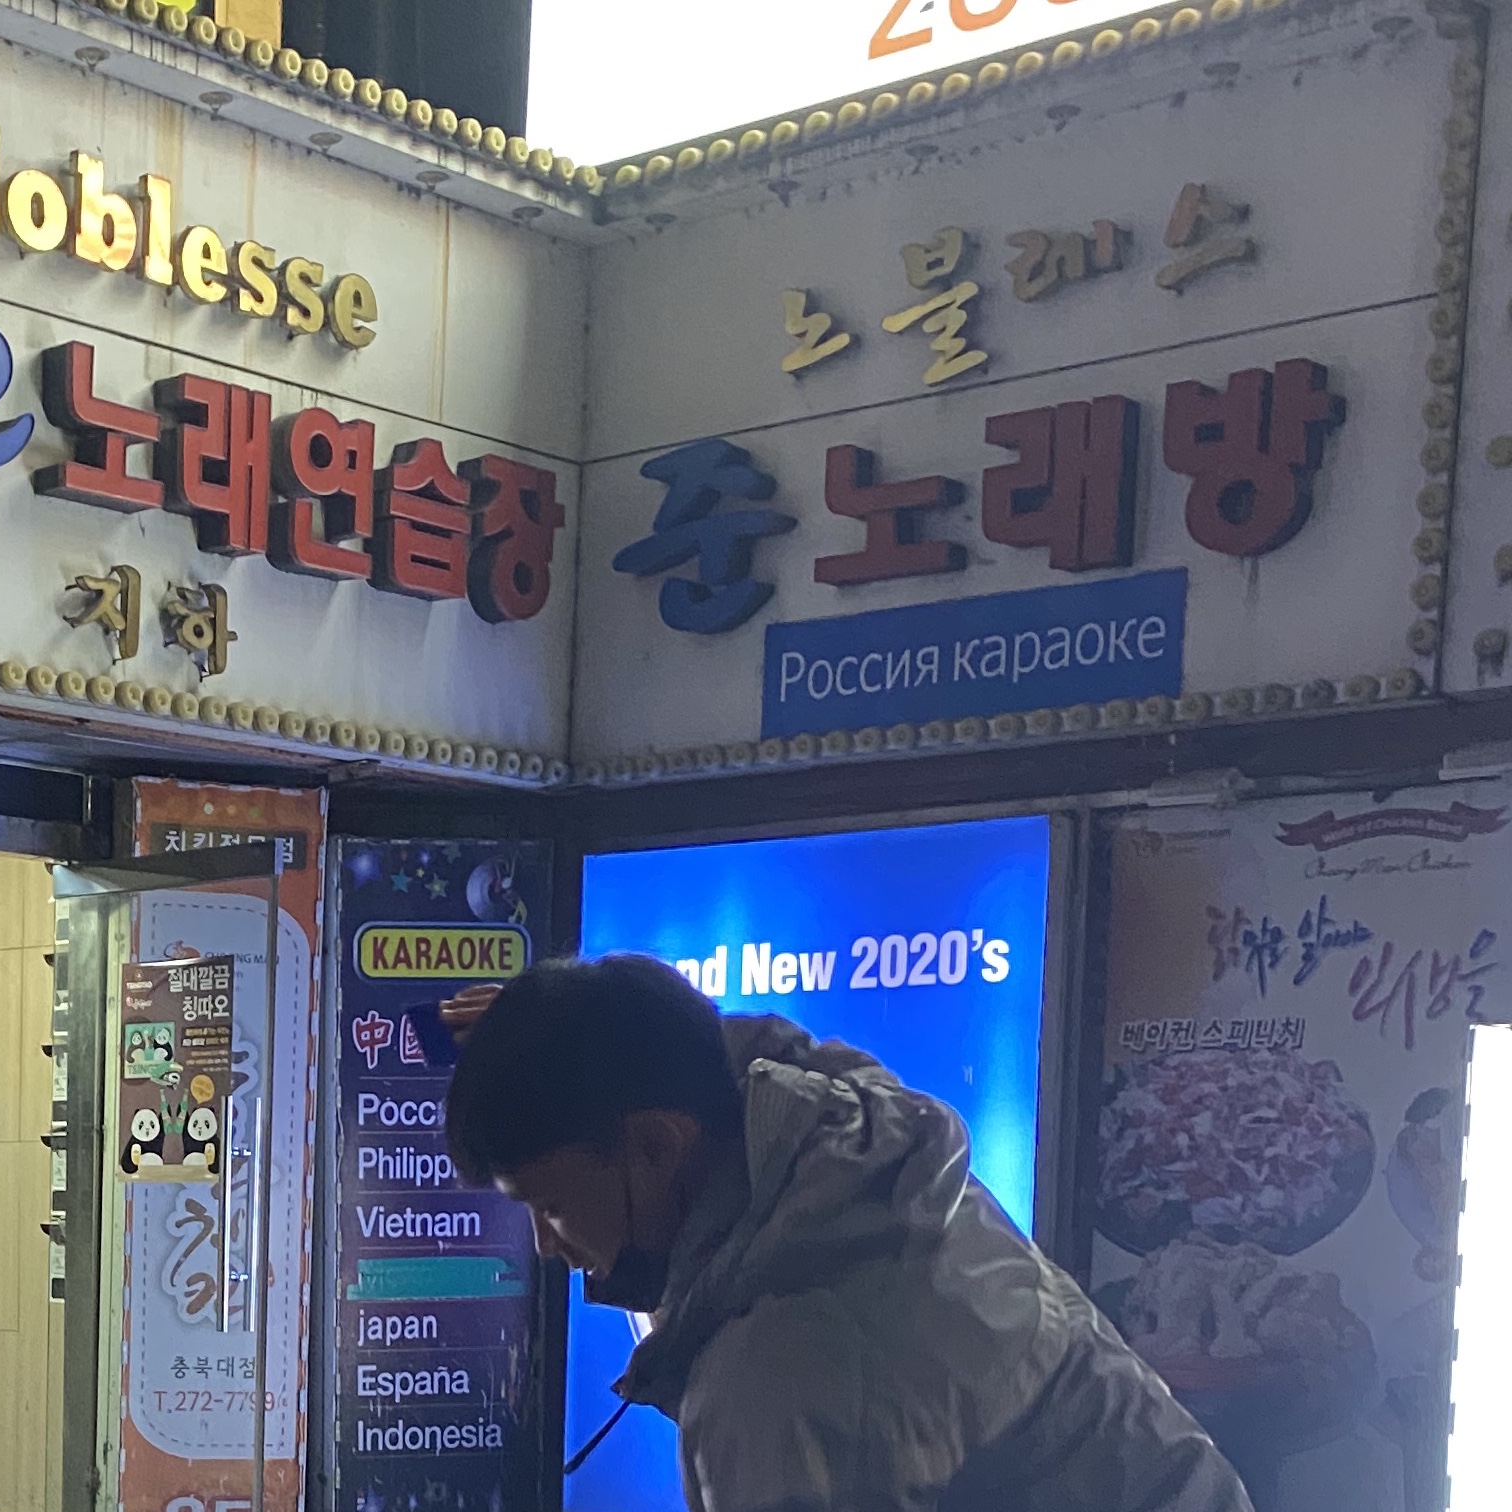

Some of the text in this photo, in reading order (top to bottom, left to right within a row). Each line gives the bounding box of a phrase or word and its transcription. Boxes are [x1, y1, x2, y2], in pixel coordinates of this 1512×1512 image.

[780, 184, 1256, 386] 노블레스
[40, 340, 565, 622] 노래연습장
[814, 358, 1346, 586] 노래방
[779, 615, 1167, 703] Россия караоке
[372, 936, 514, 971] KARAOKE
[741, 942, 836, 996] New
[850, 930, 1011, 990] 2020's
[182, 995, 231, 1021] 칭따오
[356, 1206, 481, 1238] Vietnam
[359, 1310, 438, 1346] japan
[170, 1355, 257, 1380] 충북대점
[357, 1365, 470, 1402] España
[357, 1418, 503, 1452] Indonesia
